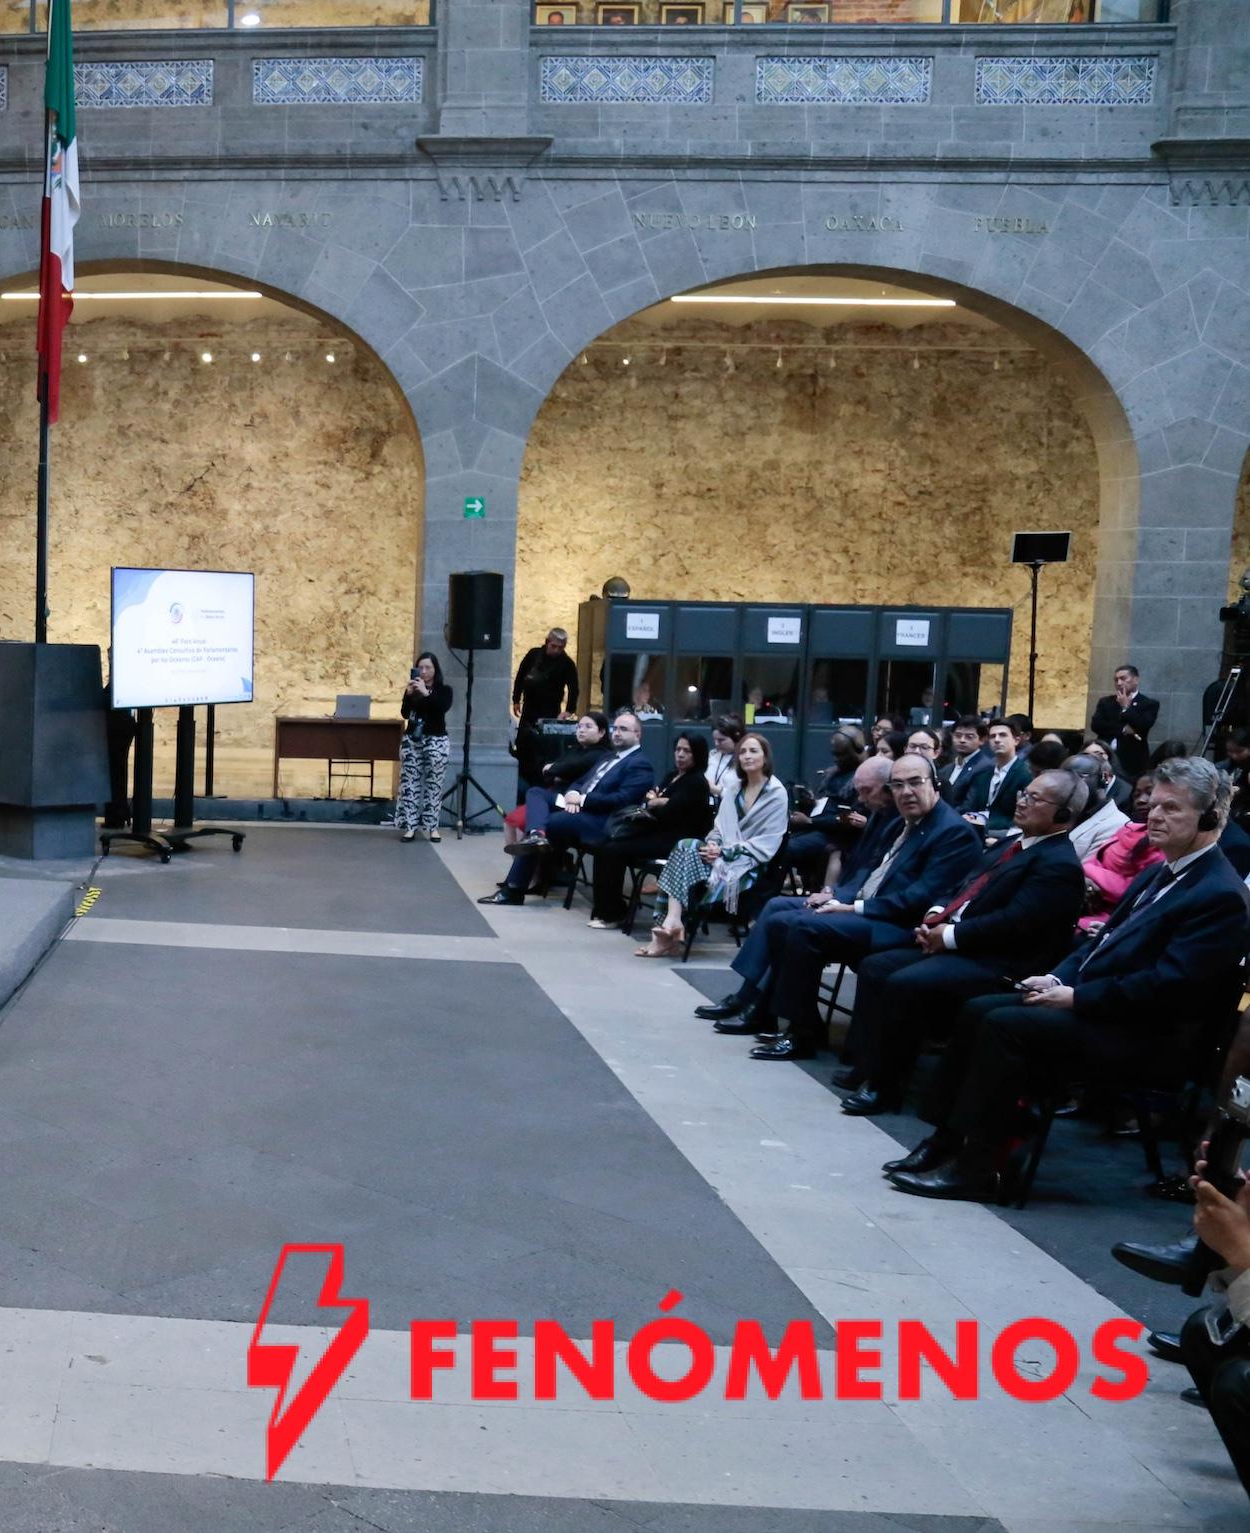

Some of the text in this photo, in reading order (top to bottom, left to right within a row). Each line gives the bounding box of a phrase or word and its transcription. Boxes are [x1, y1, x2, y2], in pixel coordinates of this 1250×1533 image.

[100, 212, 183, 229] MORELOS
[249, 211, 332, 228] NAYARIT
[632, 213, 756, 231] NUEVO LEON
[825, 215, 904, 232] OAXACA
[974, 217, 1051, 234] PUEBLA
